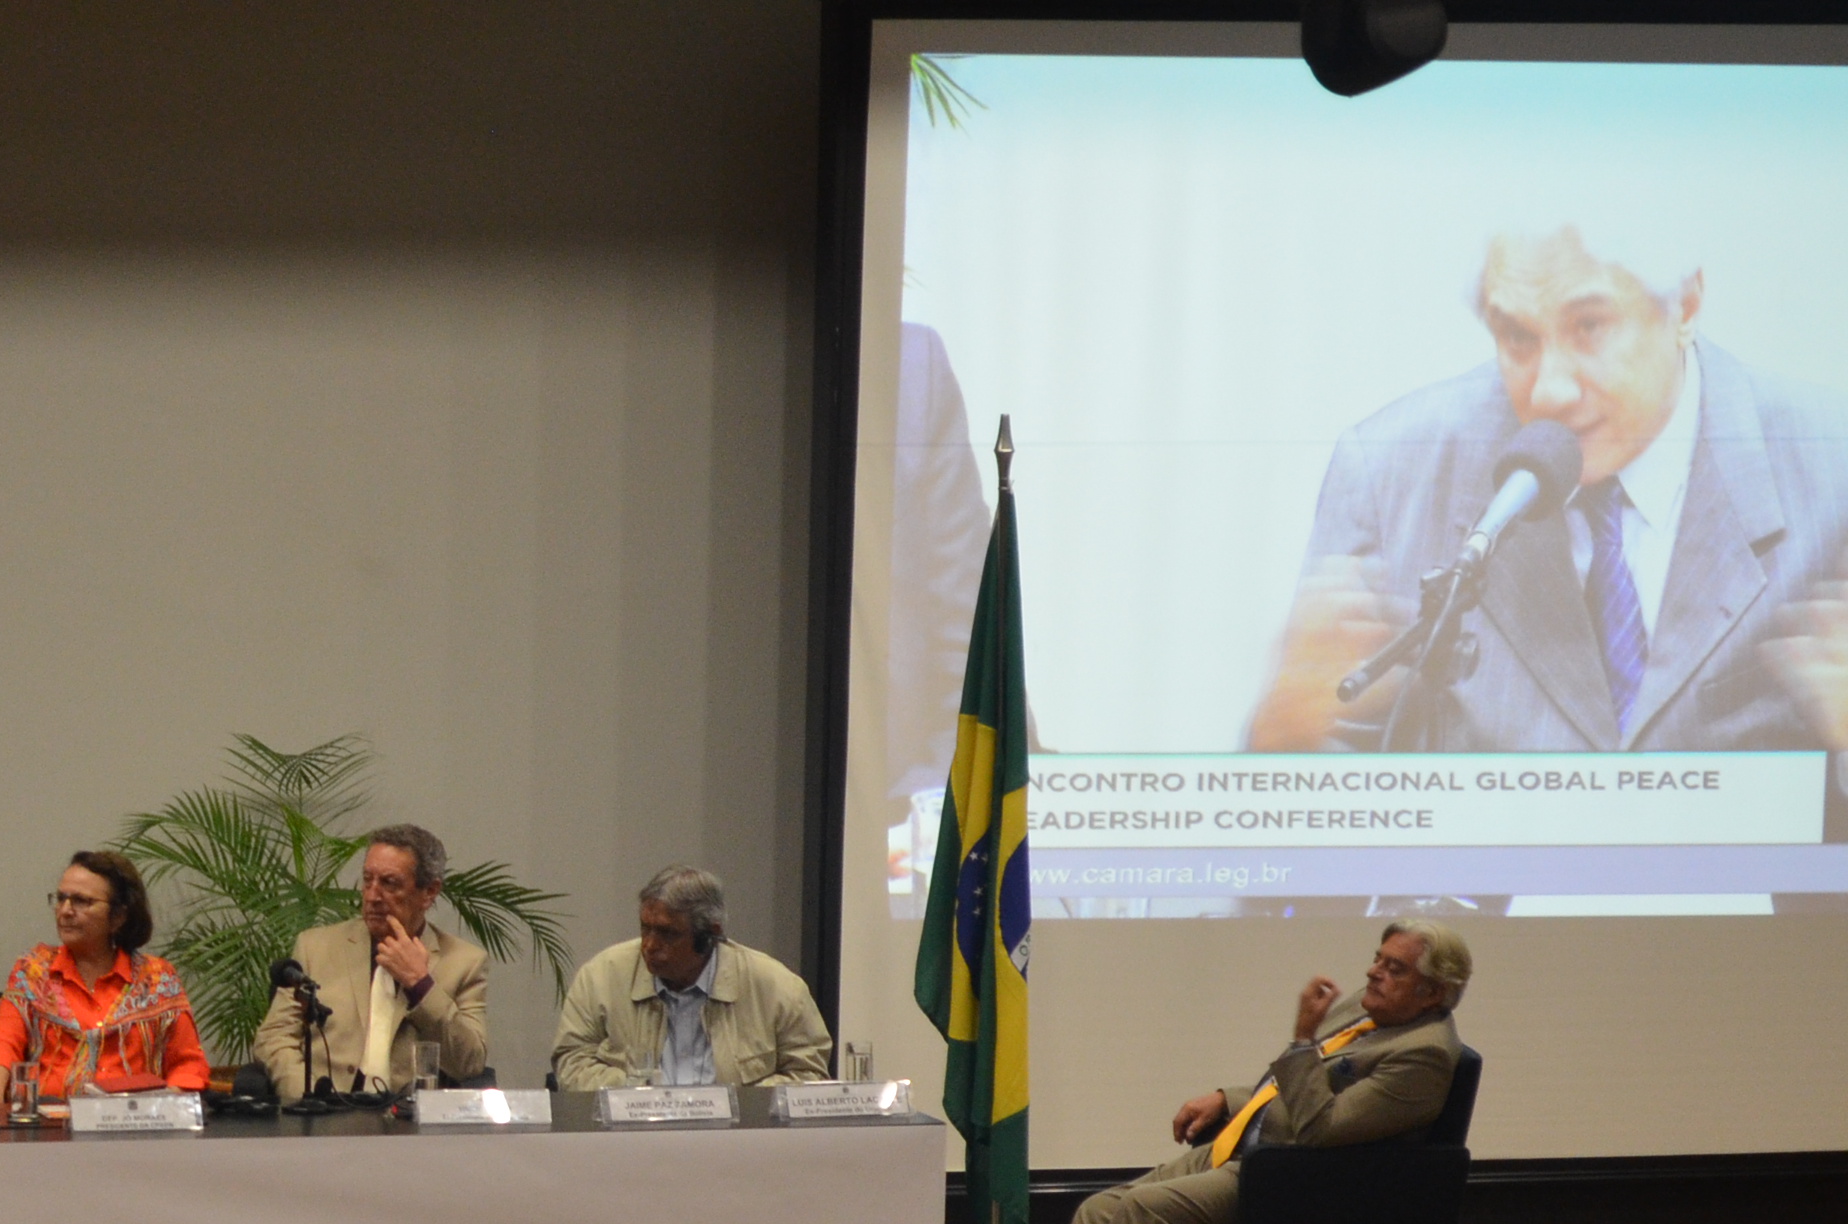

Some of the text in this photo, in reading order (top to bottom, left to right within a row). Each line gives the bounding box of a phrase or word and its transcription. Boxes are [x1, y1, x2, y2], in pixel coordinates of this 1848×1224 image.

[1028, 771, 1719, 793] NCONTRO INTERNACIONAL GLOBAL PEACE
[1025, 808, 1432, 830] EADERSHIP CONFERENCE
[1031, 861, 1291, 888] ww.camara.leg.br
[816, 1097, 858, 1105] ALBERTO
